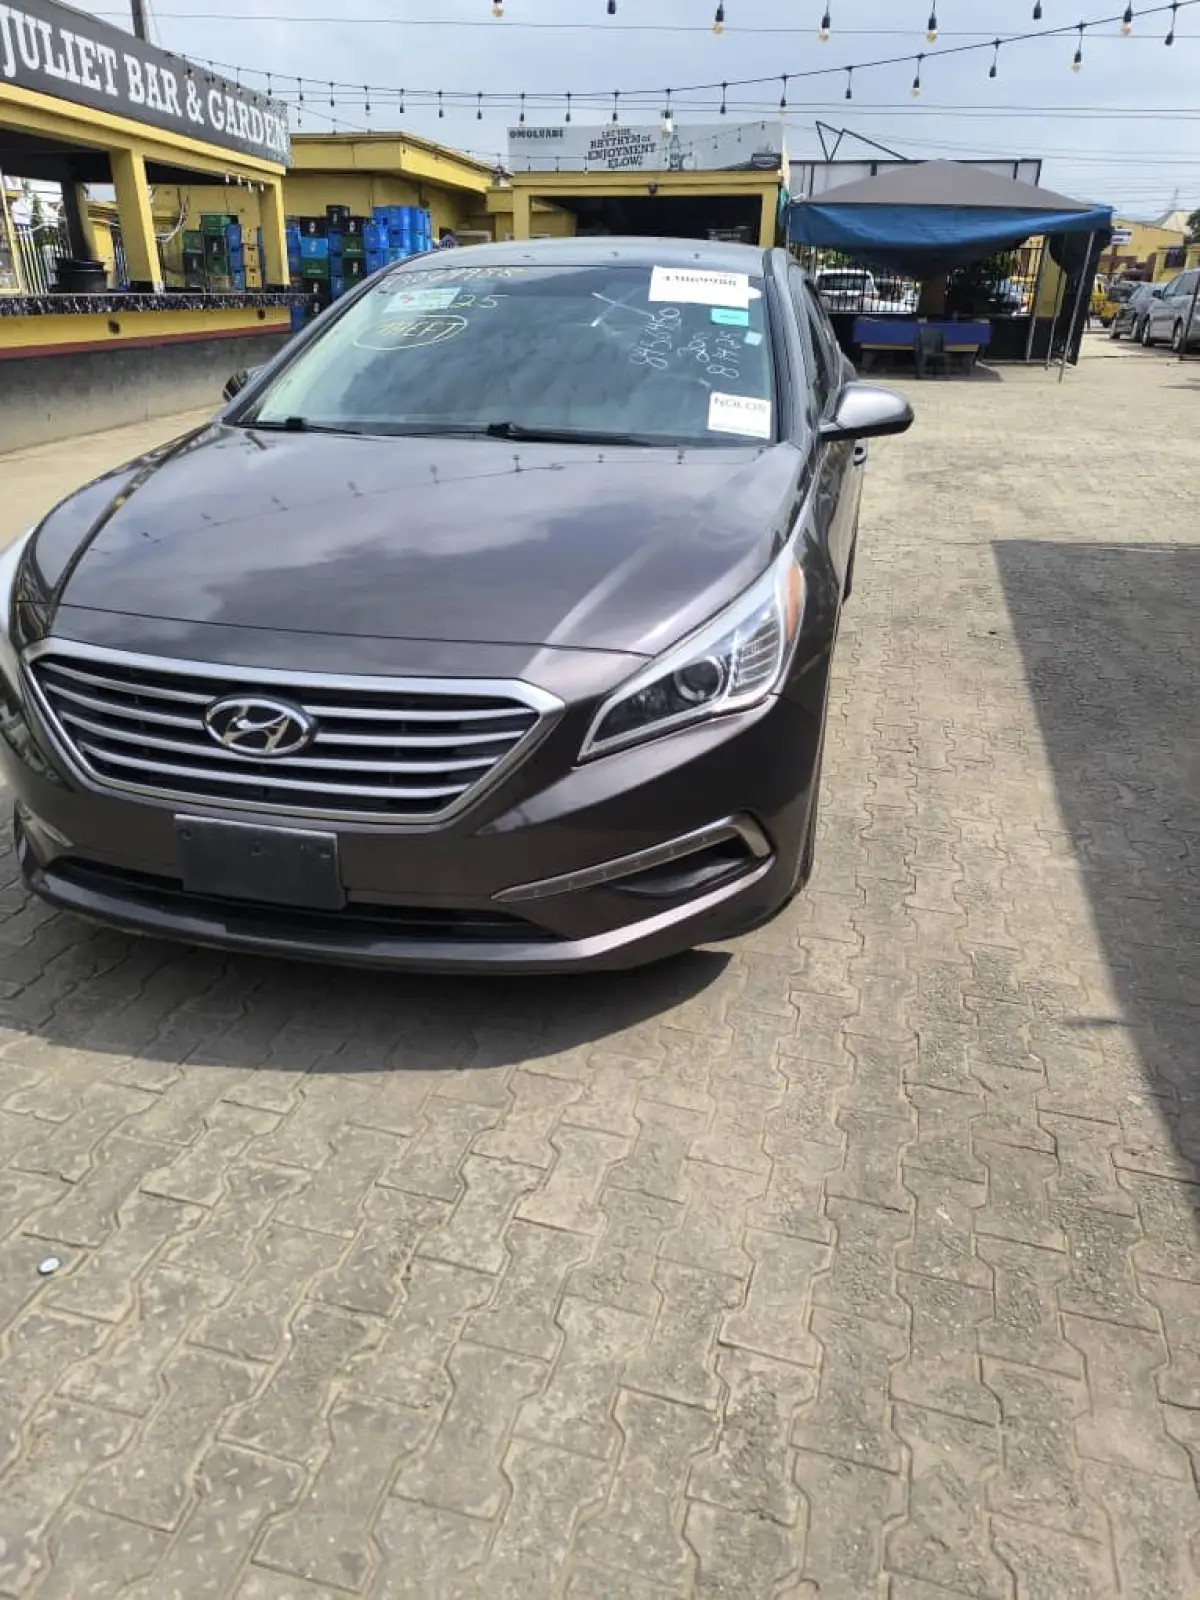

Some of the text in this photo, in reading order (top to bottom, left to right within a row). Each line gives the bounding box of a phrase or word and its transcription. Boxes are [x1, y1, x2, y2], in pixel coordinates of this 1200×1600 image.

[0, 3, 118, 97] JULIET
[123, 54, 183, 117] BAR
[186, 79, 205, 124] &
[587, 143, 656, 161] ENJOYMENT
